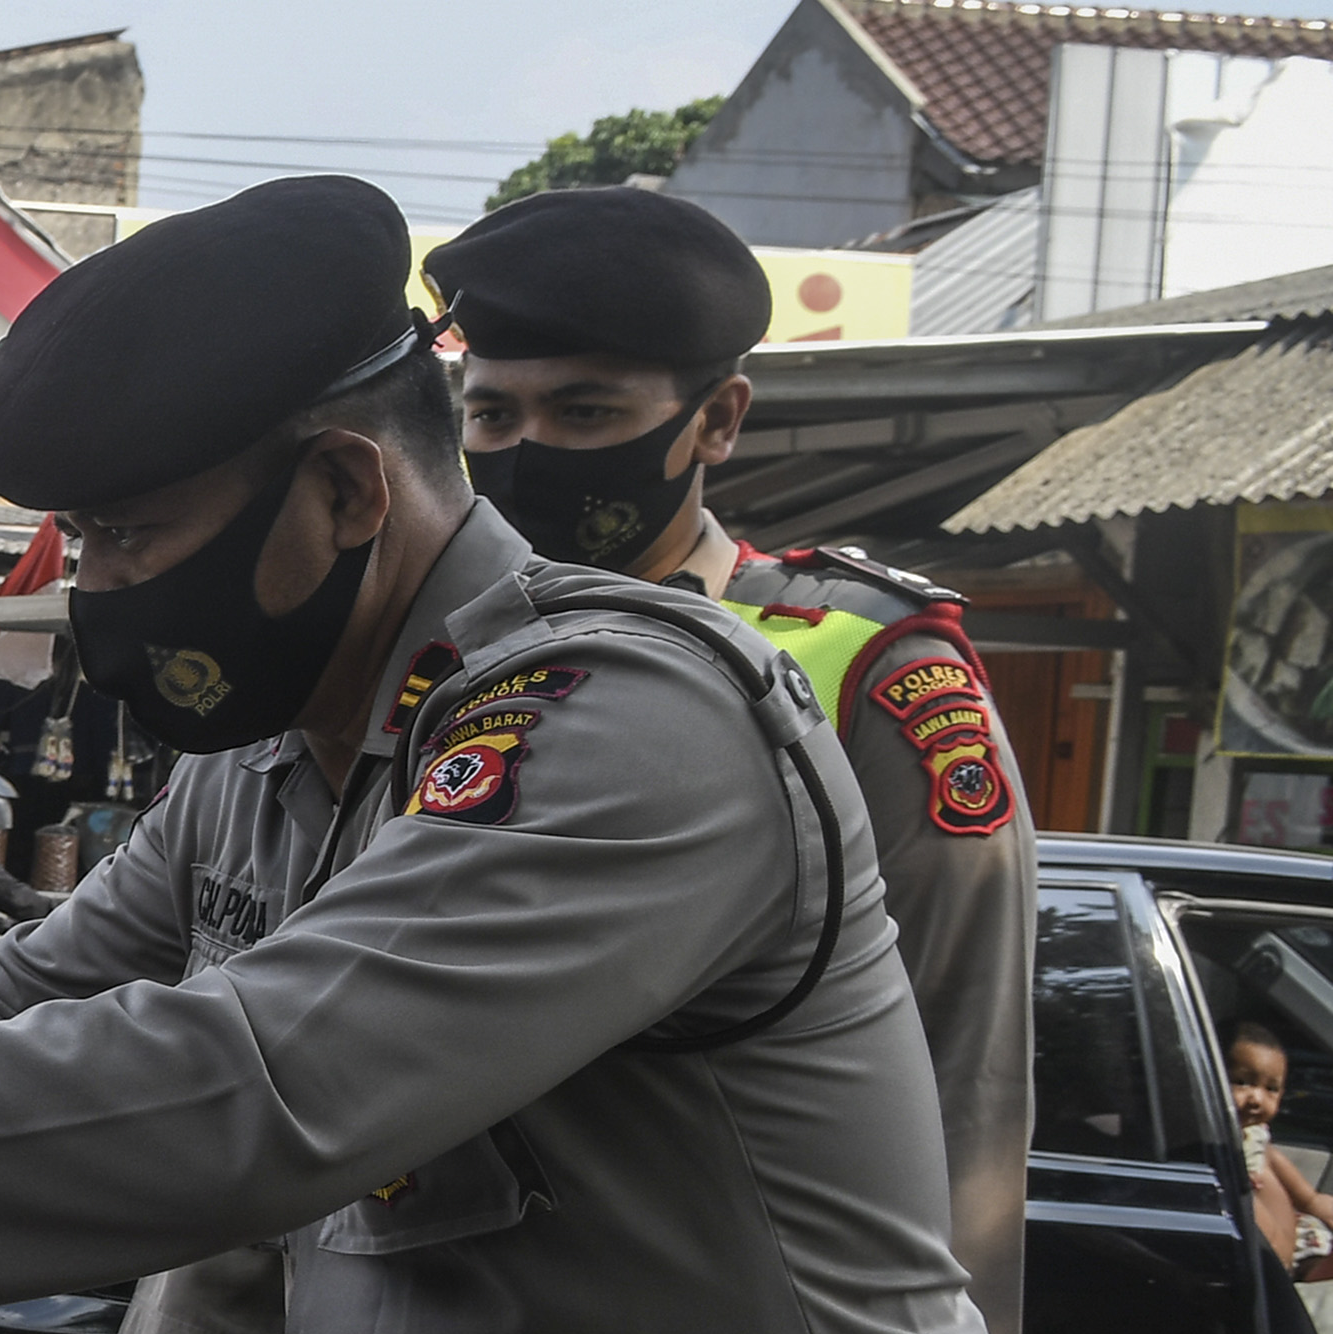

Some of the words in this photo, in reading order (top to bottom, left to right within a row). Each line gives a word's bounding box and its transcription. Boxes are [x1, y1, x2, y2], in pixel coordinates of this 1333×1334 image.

[195, 680, 231, 716] POLRI
[887, 665, 968, 701] POLRES
[444, 723, 480, 750] JAWA
[483, 713, 533, 731] BARAT
[913, 713, 951, 740] JAWA
[949, 710, 983, 726] BARAT
